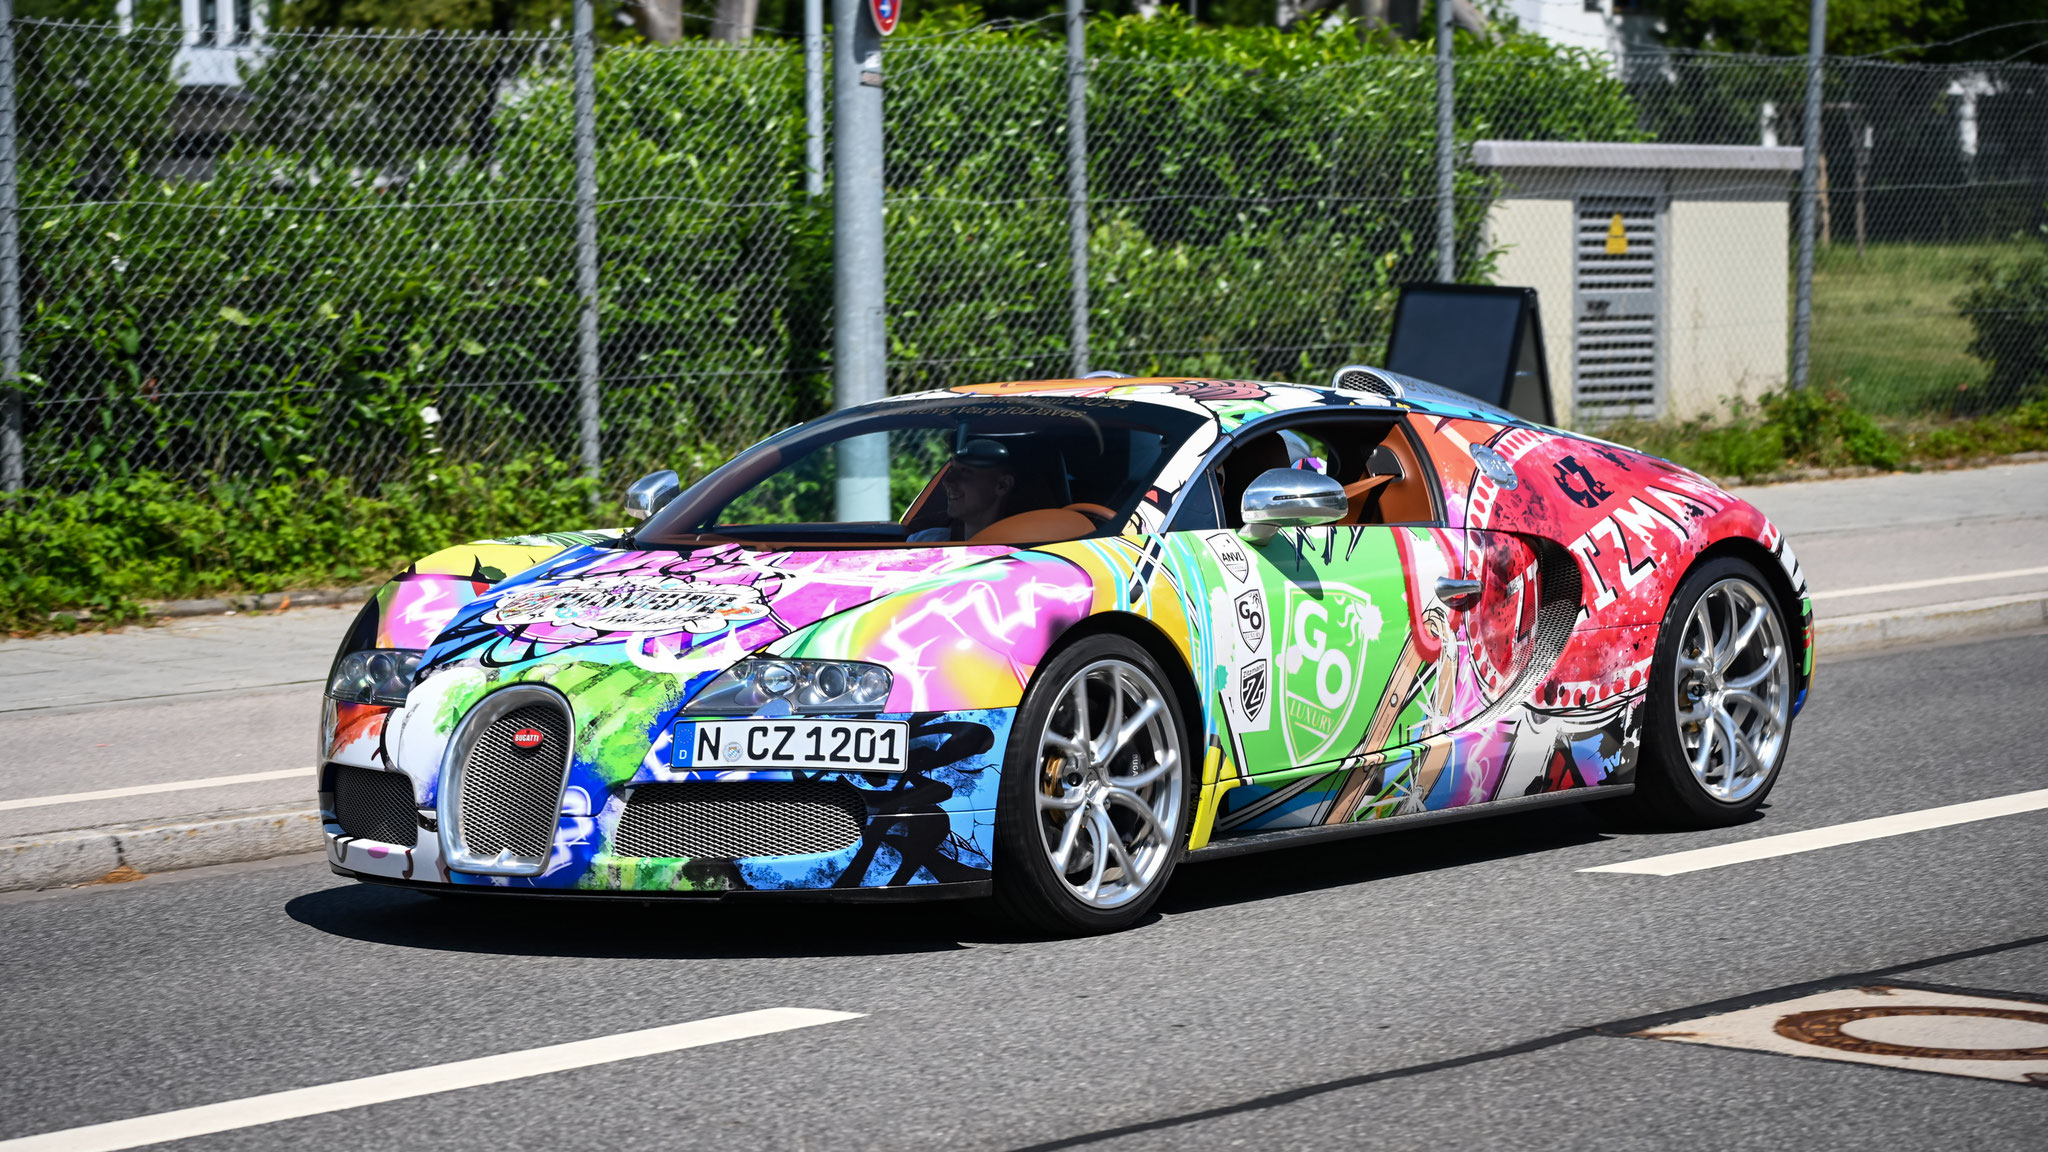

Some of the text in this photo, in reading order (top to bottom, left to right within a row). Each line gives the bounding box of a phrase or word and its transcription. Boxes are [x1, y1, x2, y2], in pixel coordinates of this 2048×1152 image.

[1222, 552, 1245, 562] ANVL
[1294, 600, 1352, 710] GO
[1290, 699, 1335, 733] LUXURY
[515, 734, 539, 742] BUGATTI
[678, 726, 900, 765] D N CZ 1201
